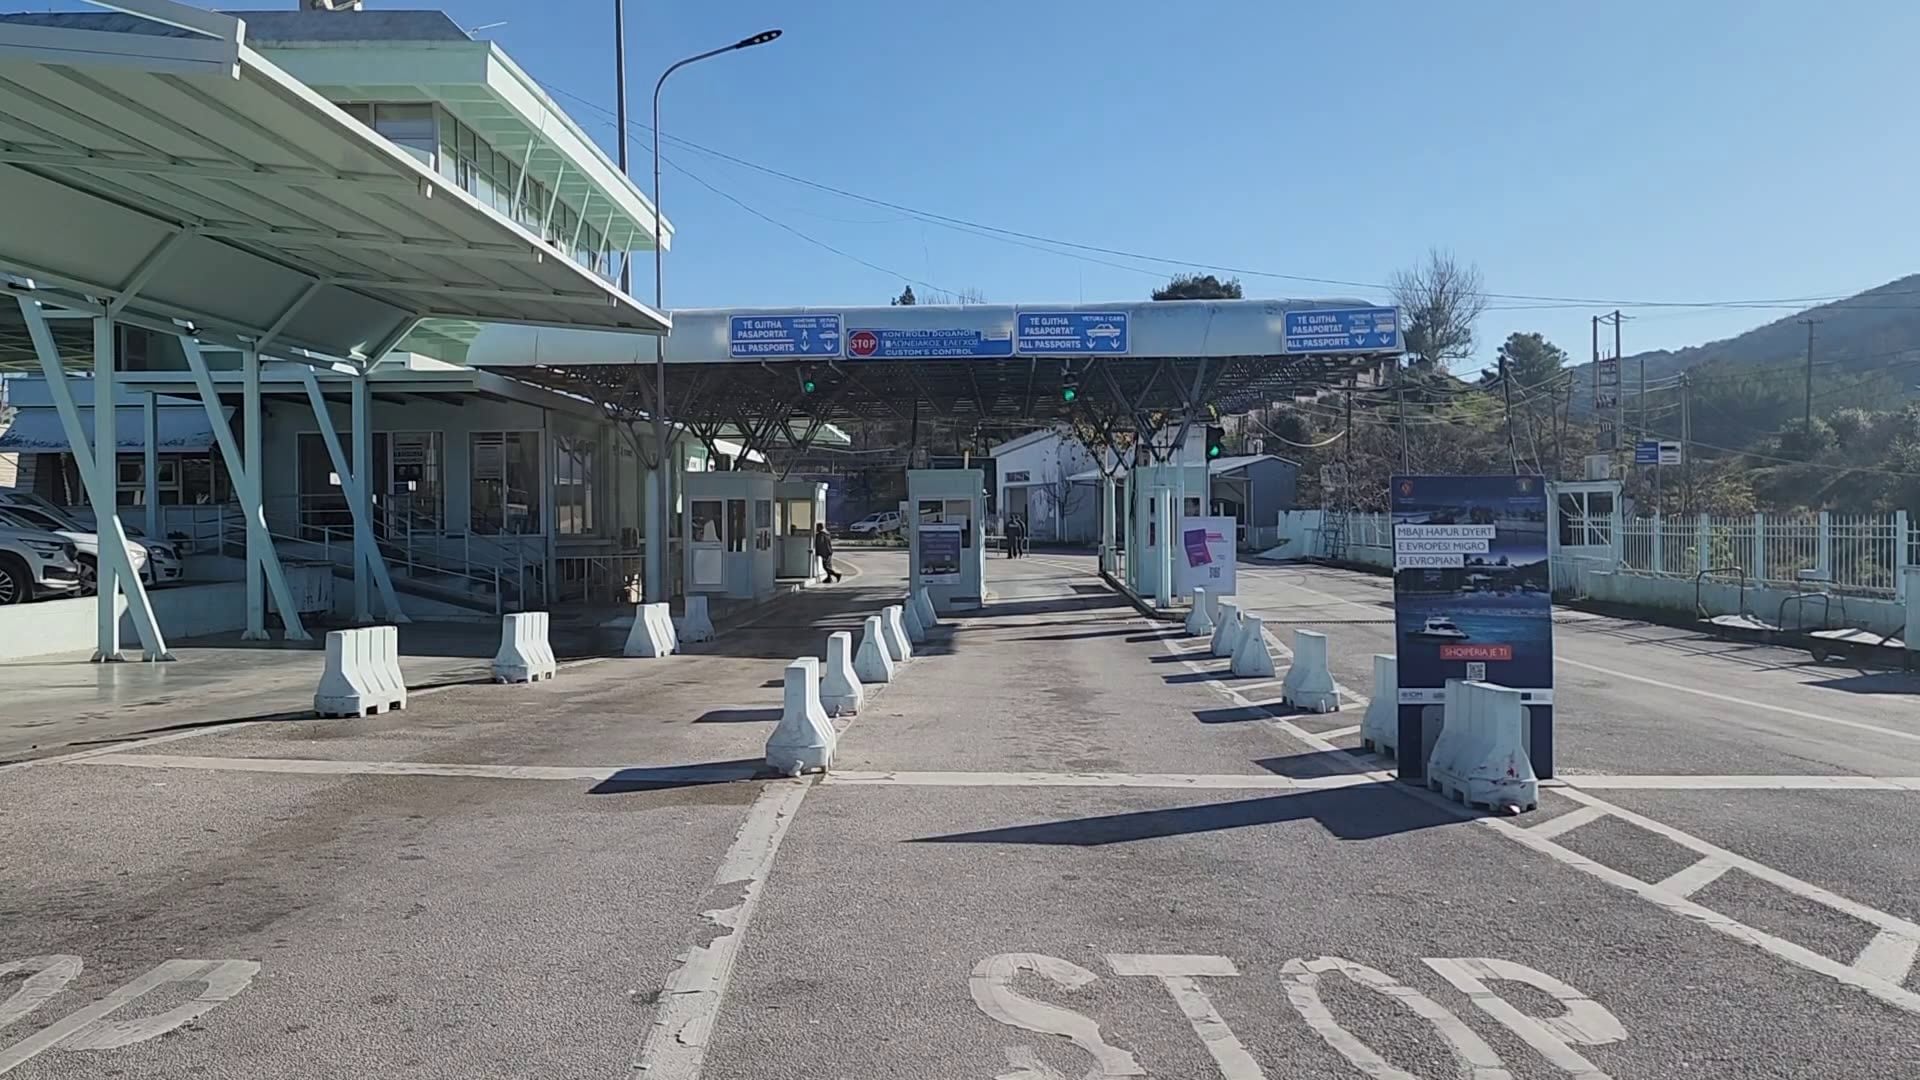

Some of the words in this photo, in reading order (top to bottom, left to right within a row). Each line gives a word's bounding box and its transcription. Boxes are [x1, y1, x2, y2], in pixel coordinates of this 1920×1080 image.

[1041, 317, 1069, 325] GJITHA
[1308, 315, 1337, 324] GJITHA
[754, 320, 782, 329] GJITHA
[1025, 327, 1074, 335] PASAPORTAT
[1292, 325, 1343, 334] PASAPORTAT
[738, 330, 787, 339] PASAPORTAT
[851, 338, 876, 349] STOP
[1019, 340, 1033, 348] ALL
[1035, 340, 1081, 348] PASSPORTS
[1287, 339, 1301, 348] ALL
[1303, 337, 1350, 347] PASSPORTS
[733, 344, 746, 352] ALL
[748, 343, 794, 352] PASSPORTS
[1397, 527, 1424, 537] MBAJI
[1426, 527, 1459, 536] HAPUR
[1462, 527, 1492, 536] DYERT
[1398, 542, 1405, 551] E
[1453, 542, 1486, 551] MIGRO
[1399, 556, 1407, 565] SI
[1409, 556, 1460, 565] EVROPIAN!
[1489, 648, 1497, 657] JE
[1499, 647, 1507, 656] TI
[969, 952, 1628, 1080] STOP
